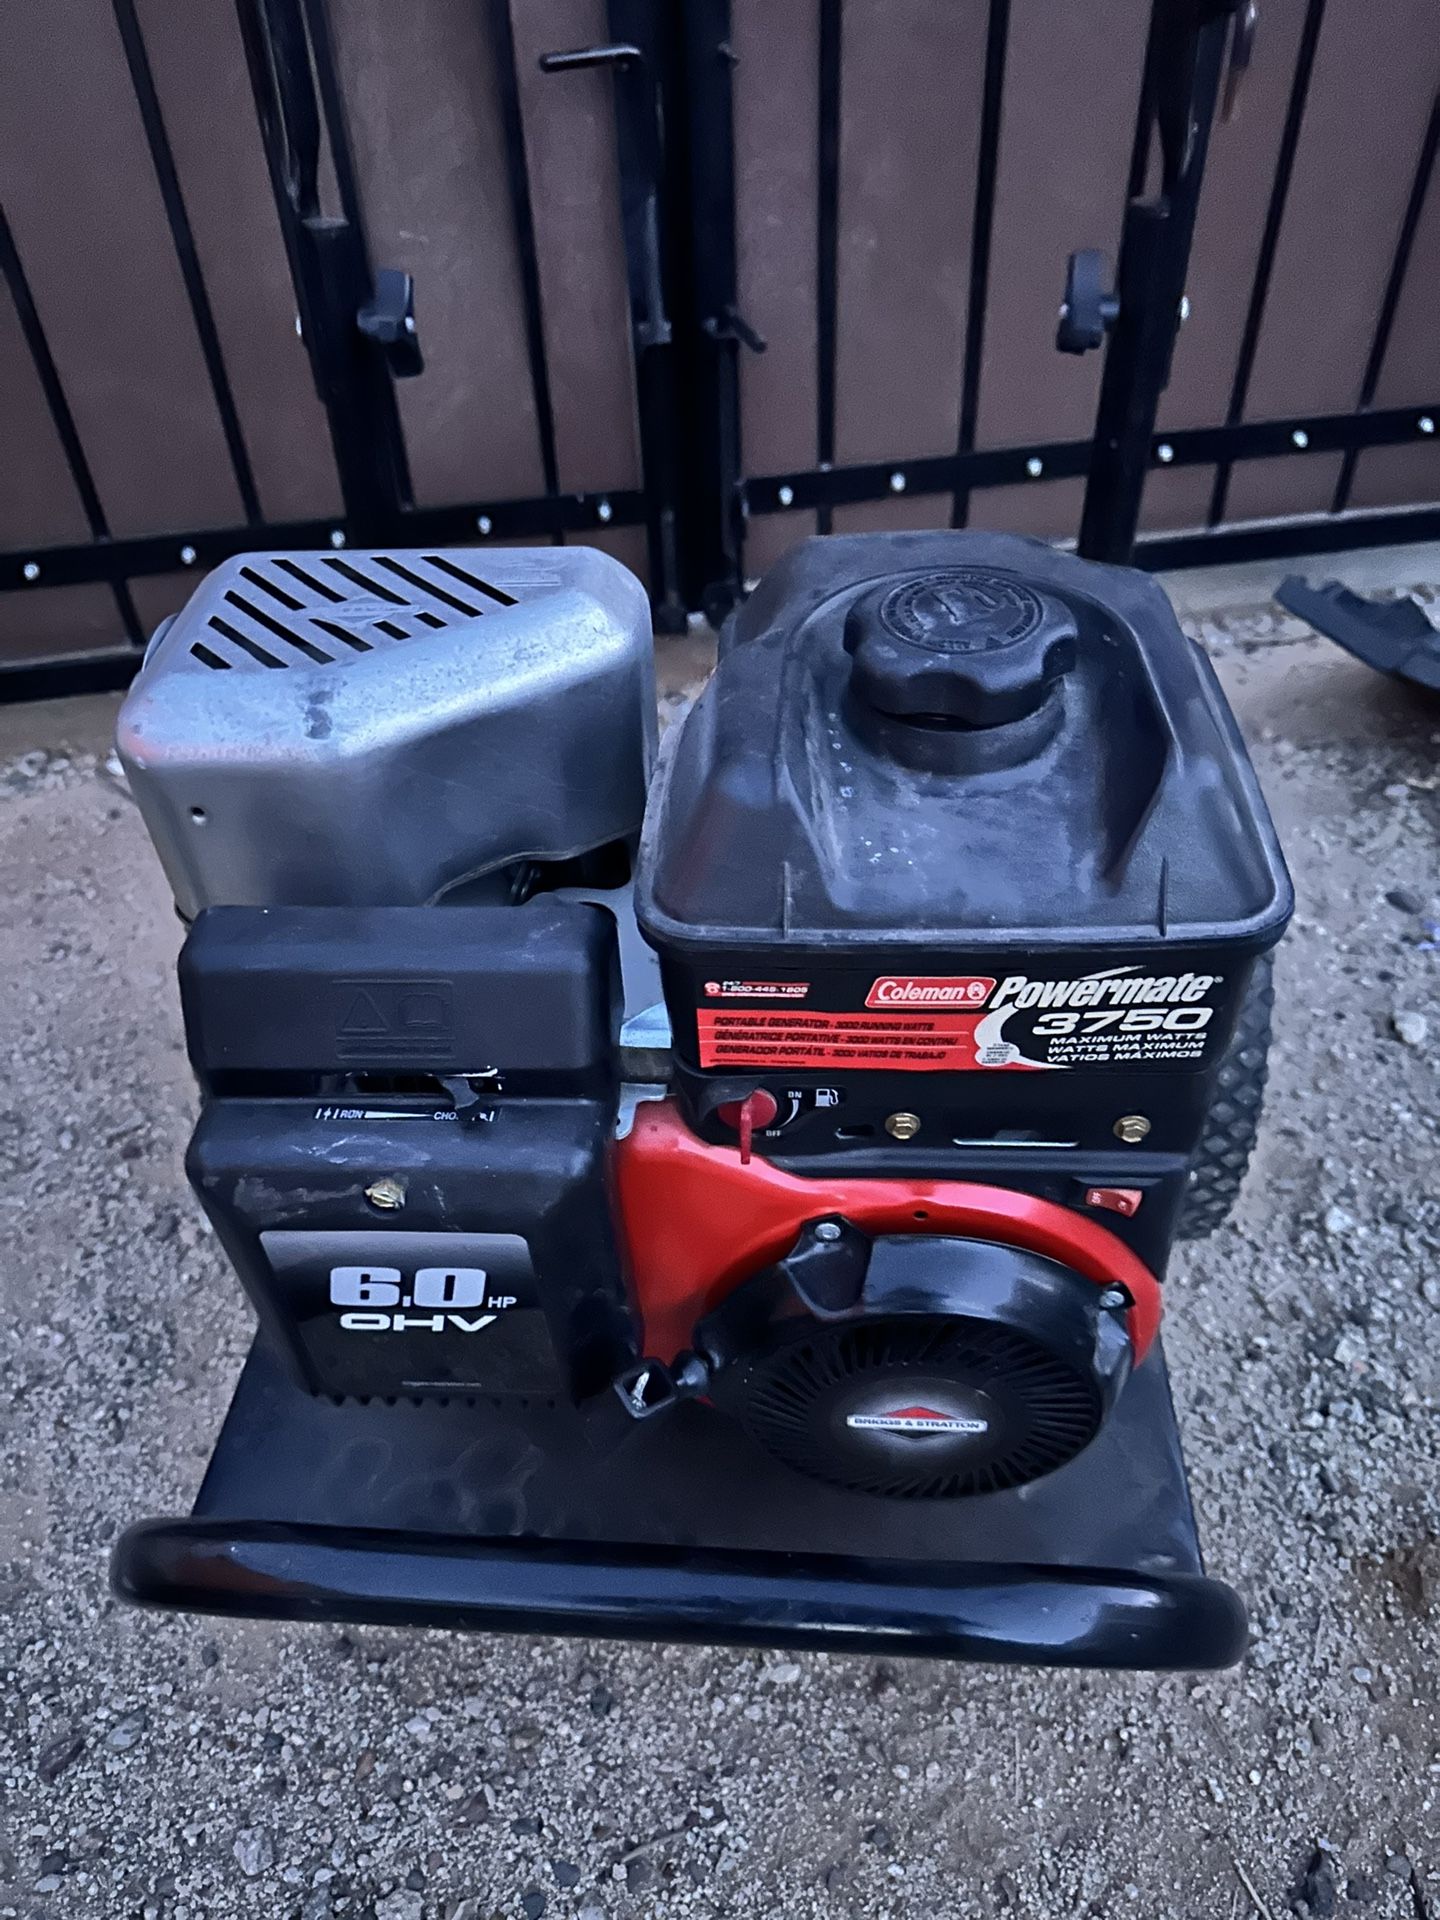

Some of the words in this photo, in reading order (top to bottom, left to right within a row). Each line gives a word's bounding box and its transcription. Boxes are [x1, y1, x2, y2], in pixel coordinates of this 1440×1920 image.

[877, 981, 965, 1001] Coleman
[988, 972, 1216, 1010] Powermate
[714, 1016, 767, 1027] PORTABLE
[767, 1017, 830, 1029] GENERATOR
[859, 1022, 903, 1031] RUNNING
[903, 1022, 935, 1031] WATTS
[1032, 1007, 1214, 1035] 3750
[784, 1032, 841, 1043] PORTATIVE
[870, 1036, 901, 1045] WATTS
[902, 1037, 917, 1046] EN
[916, 1037, 958, 1046] CONTINU
[1049, 1034, 1141, 1045] MAXIMUM
[1146, 1032, 1207, 1041] WATTS
[715, 1045, 778, 1056] GENERADOR
[778, 1045, 826, 1057] PORTÁTIL
[889, 1050, 902, 1059] DE
[904, 1051, 947, 1060] TRABAJO
[1048, 1044, 1109, 1054] WATTS
[1112, 1041, 1204, 1052] MAXIMUM
[1046, 1053, 1110, 1063] VATIOS
[787, 1091, 803, 1099] ON
[339, 1109, 365, 1119] RUN
[765, 1129, 782, 1137] OFF
[329, 1266, 487, 1308] 6.0
[487, 1296, 517, 1308] HP
[340, 1312, 497, 1332] OHV
[854, 1417, 902, 1426] BRIGGS
[904, 1419, 914, 1427] &
[916, 1420, 980, 1430] STRATTON
